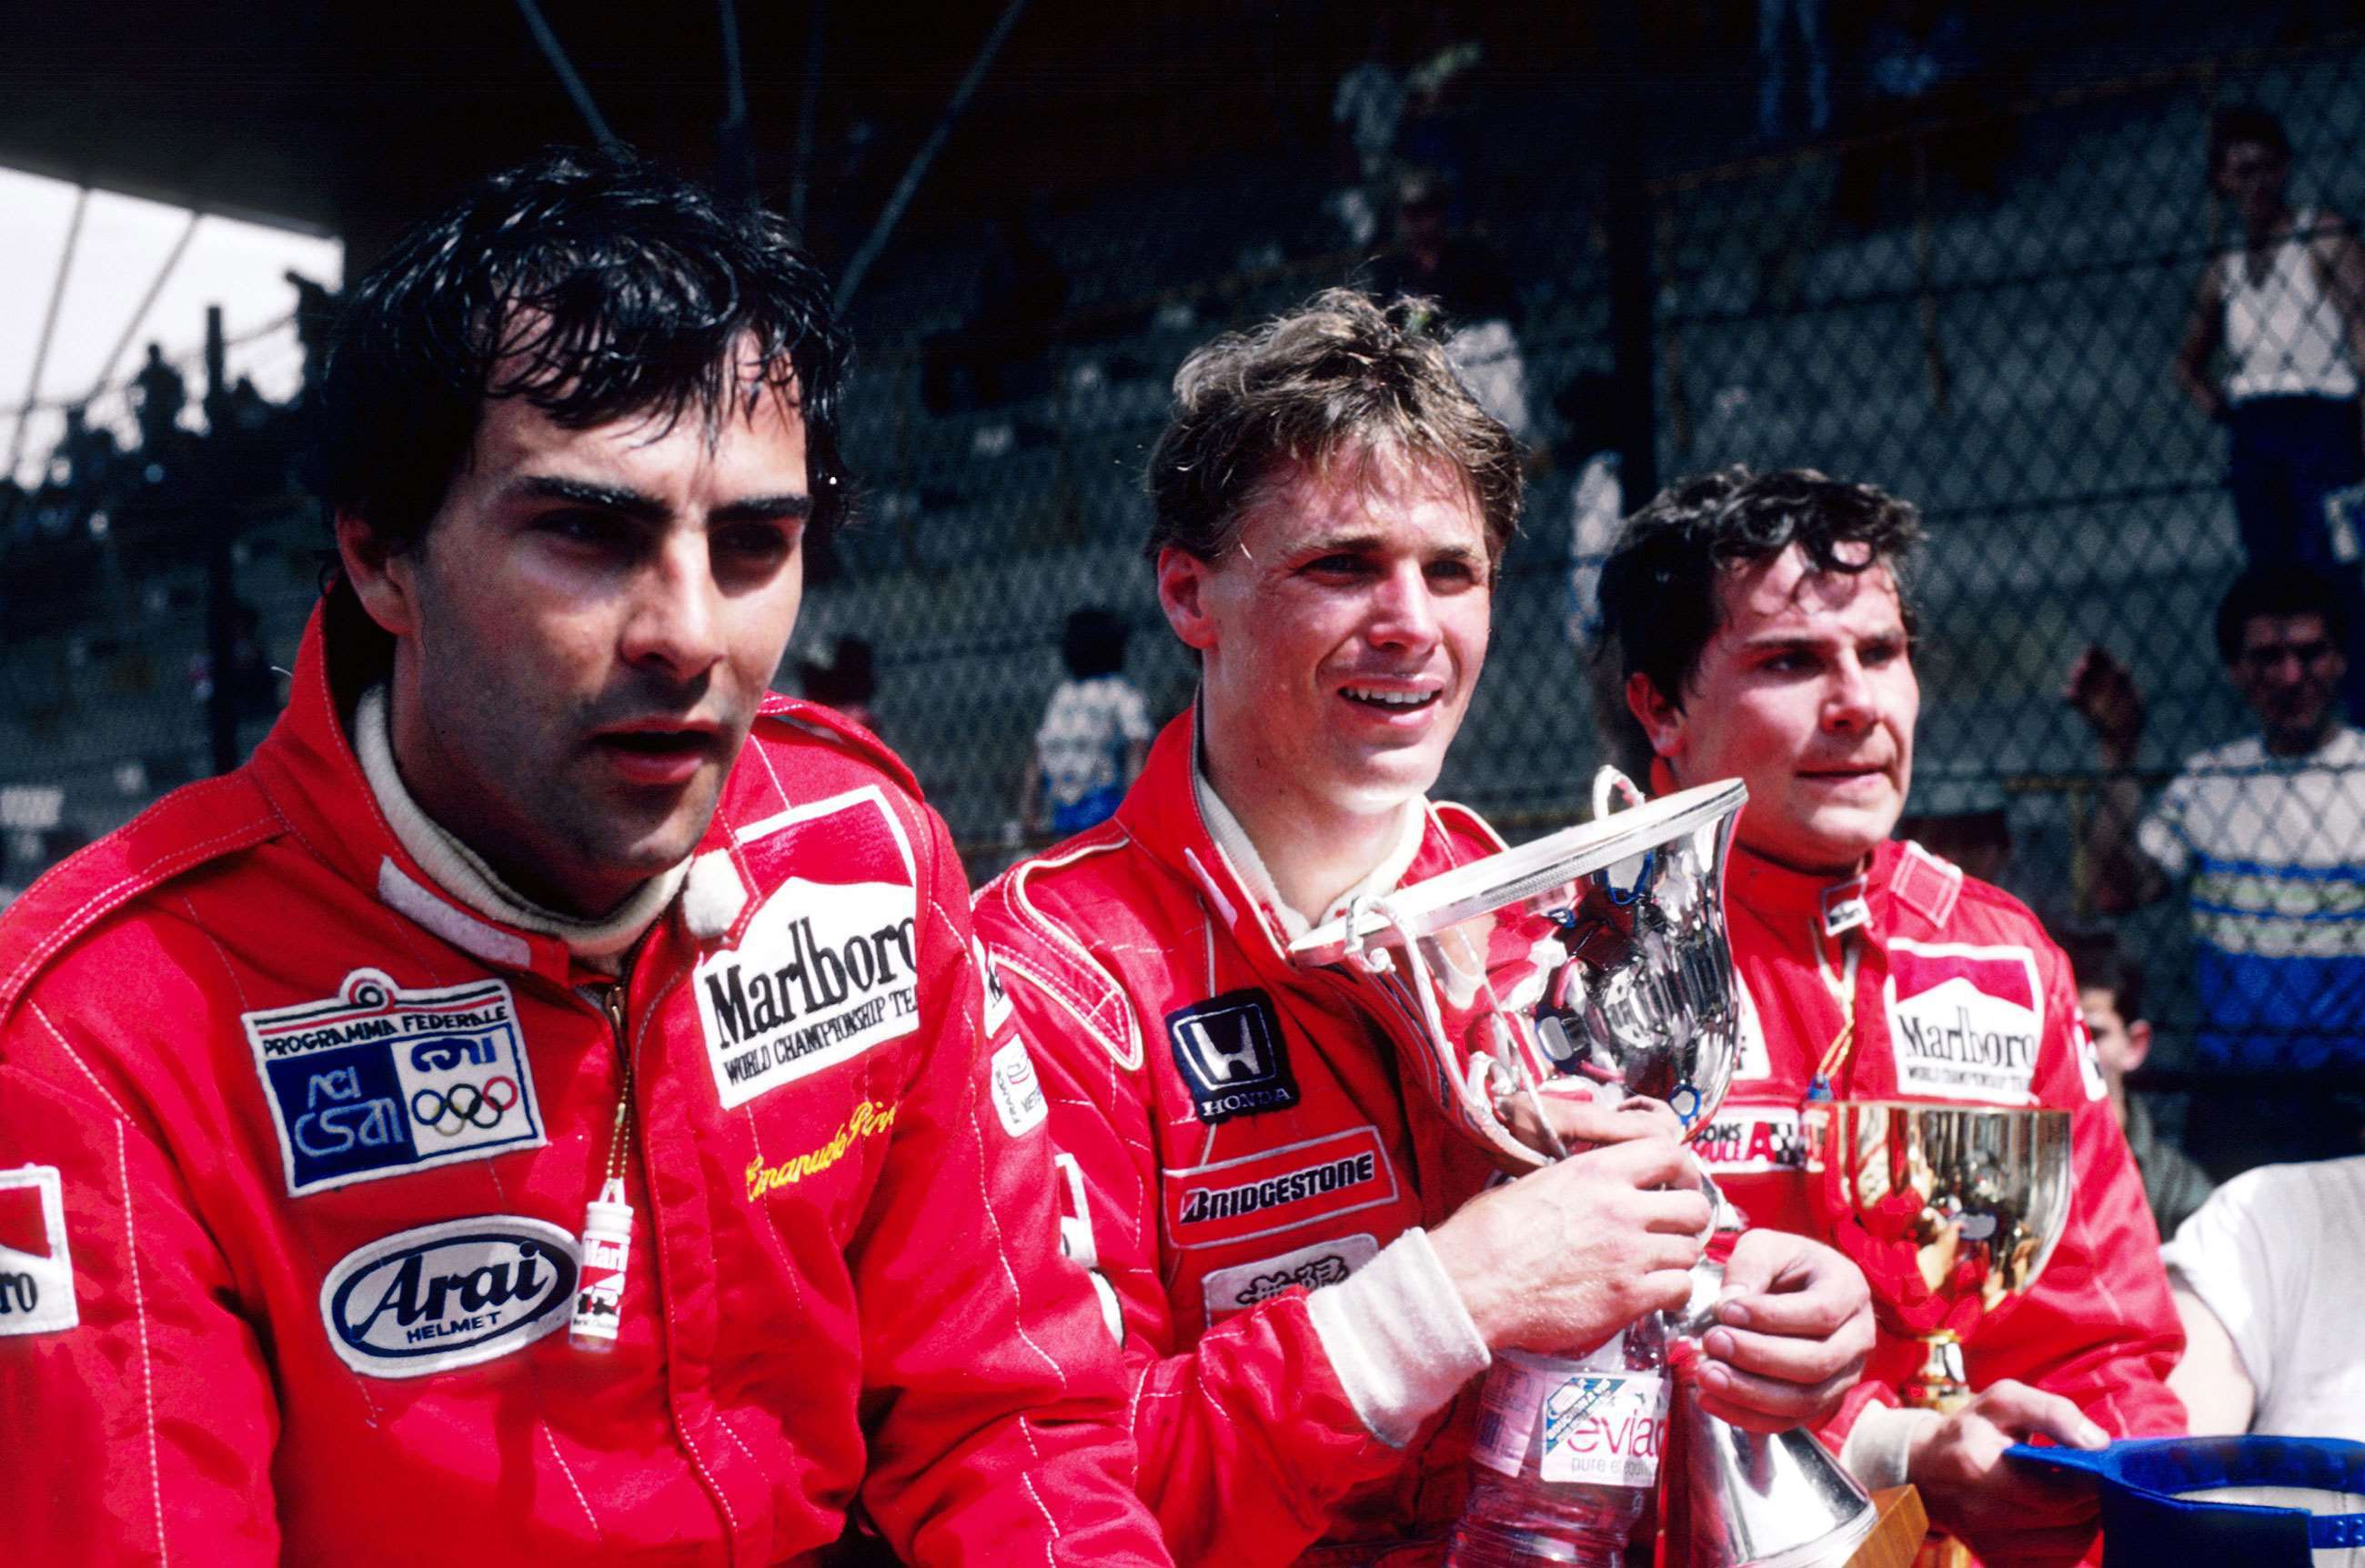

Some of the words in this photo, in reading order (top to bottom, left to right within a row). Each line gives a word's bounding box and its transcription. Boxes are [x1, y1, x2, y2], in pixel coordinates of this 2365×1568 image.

[263, 1018, 398, 1057] PROGRAMMA
[401, 1006, 508, 1033] FEDERALE
[723, 1044, 771, 1086] WORLD
[773, 997, 886, 1065] CHAMPIONSHIP
[1897, 1006, 2035, 1069] Marlboro
[1201, 1088, 1291, 1116] HONDA
[1179, 1151, 1374, 1225] BRIDGESTONE
[349, 1241, 550, 1343] Arai
[406, 1311, 501, 1343] HELMET
